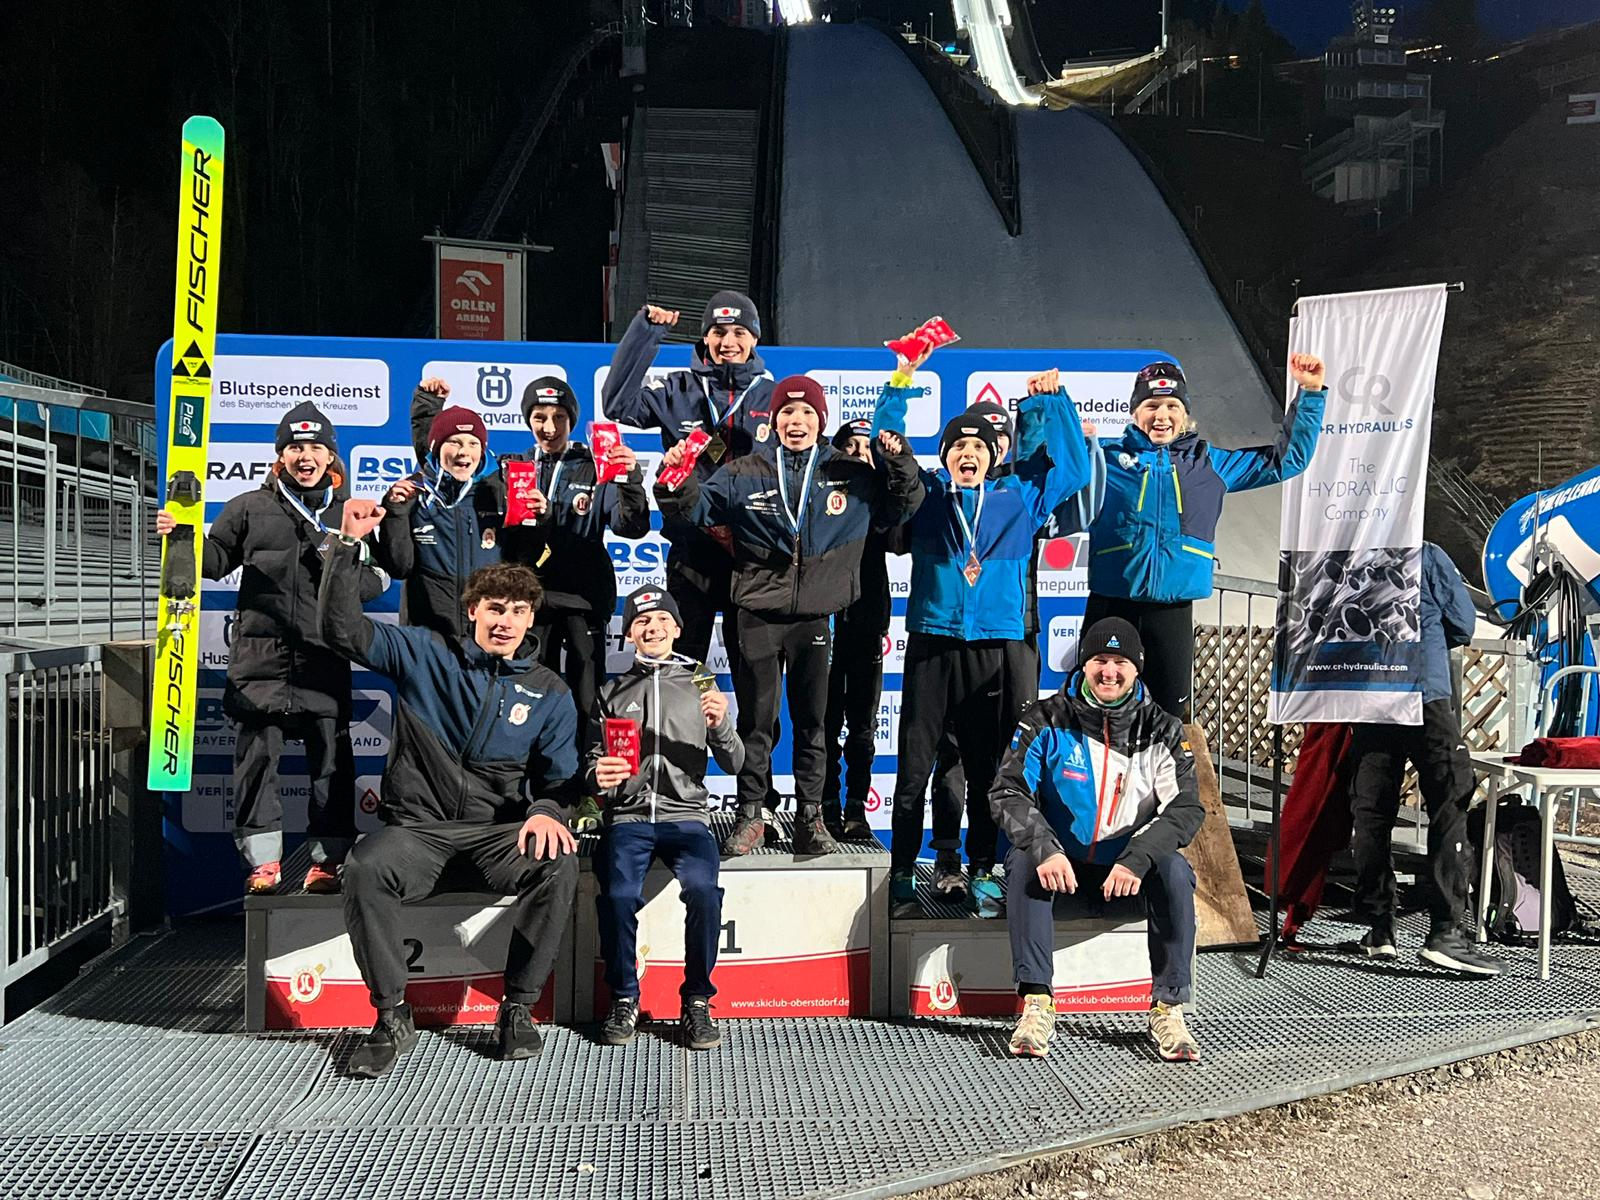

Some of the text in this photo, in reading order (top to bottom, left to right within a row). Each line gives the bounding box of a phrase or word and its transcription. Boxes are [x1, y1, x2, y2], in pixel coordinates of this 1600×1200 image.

[186, 147, 212, 333] FISCHER
[450, 298, 496, 313] ORLEN
[456, 313, 490, 323] ARENA
[219, 381, 381, 399] Blutspendedienst
[843, 386, 932, 396] SICHES
[220, 400, 236, 408] des
[238, 400, 292, 410] Bayerischen
[323, 402, 358, 411] Kreuzes
[842, 399, 876, 408] KAMM
[842, 411, 874, 420] BAYE
[1339, 418, 1413, 434] HYDRAULIS
[206, 462, 276, 481] RAF
[1349, 457, 1376, 474] The
[1324, 503, 1389, 521] Compny
[1306, 662, 1408, 671] www.cr-hydraulics.com
[163, 634, 185, 776] FISCHER
[720, 920, 742, 954] 1
[403, 938, 425, 973] 2
[730, 997, 850, 1009] www.skiclub-oberstdorf.de
[1053, 993, 1153, 1006] ww.skiclub-oberstdorf.d
[413, 1002, 500, 1014] www.skiclub-obers
